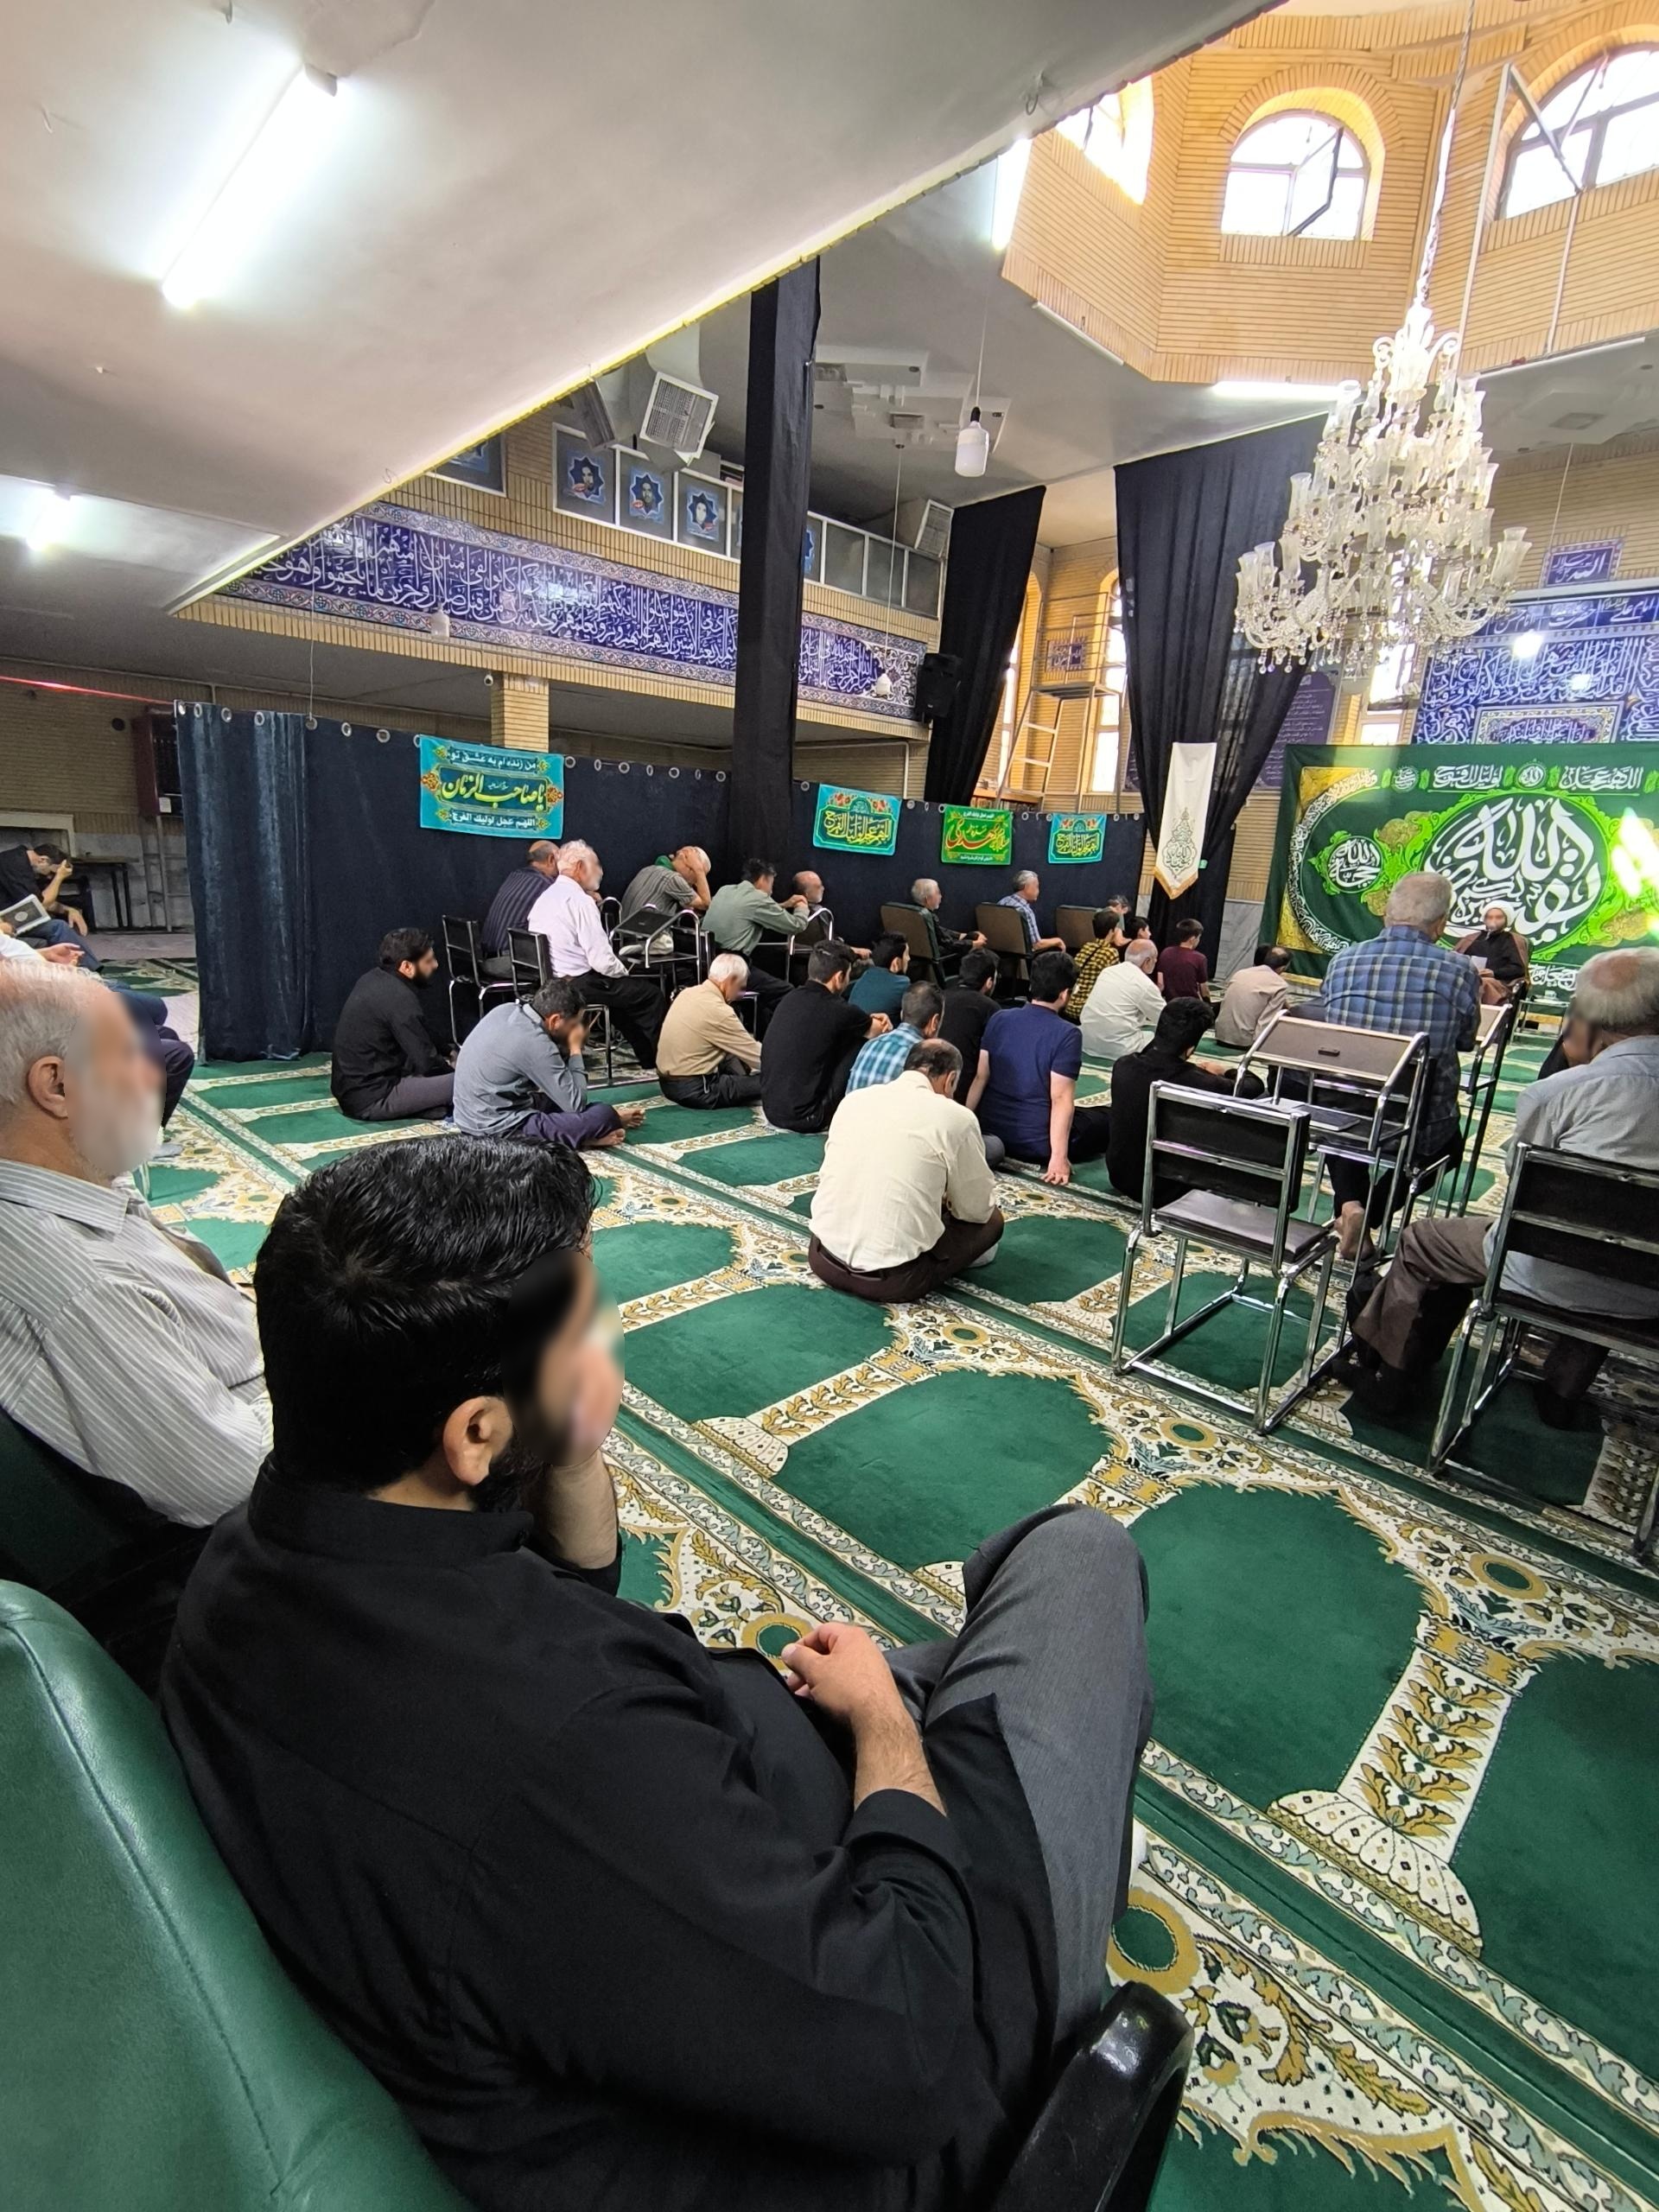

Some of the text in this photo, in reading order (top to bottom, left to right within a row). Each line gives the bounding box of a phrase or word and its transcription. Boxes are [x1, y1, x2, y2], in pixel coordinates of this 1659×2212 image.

[449, 749, 461, 760] تو
[461, 751, 487, 764] عشق
[487, 756, 497, 768] به
[507, 759, 524, 771] زنده
[525, 762, 537, 771] من
[450, 811, 473, 823] الفرج
[496, 814, 515, 826] عجل
[516, 815, 536, 830] اللهم
